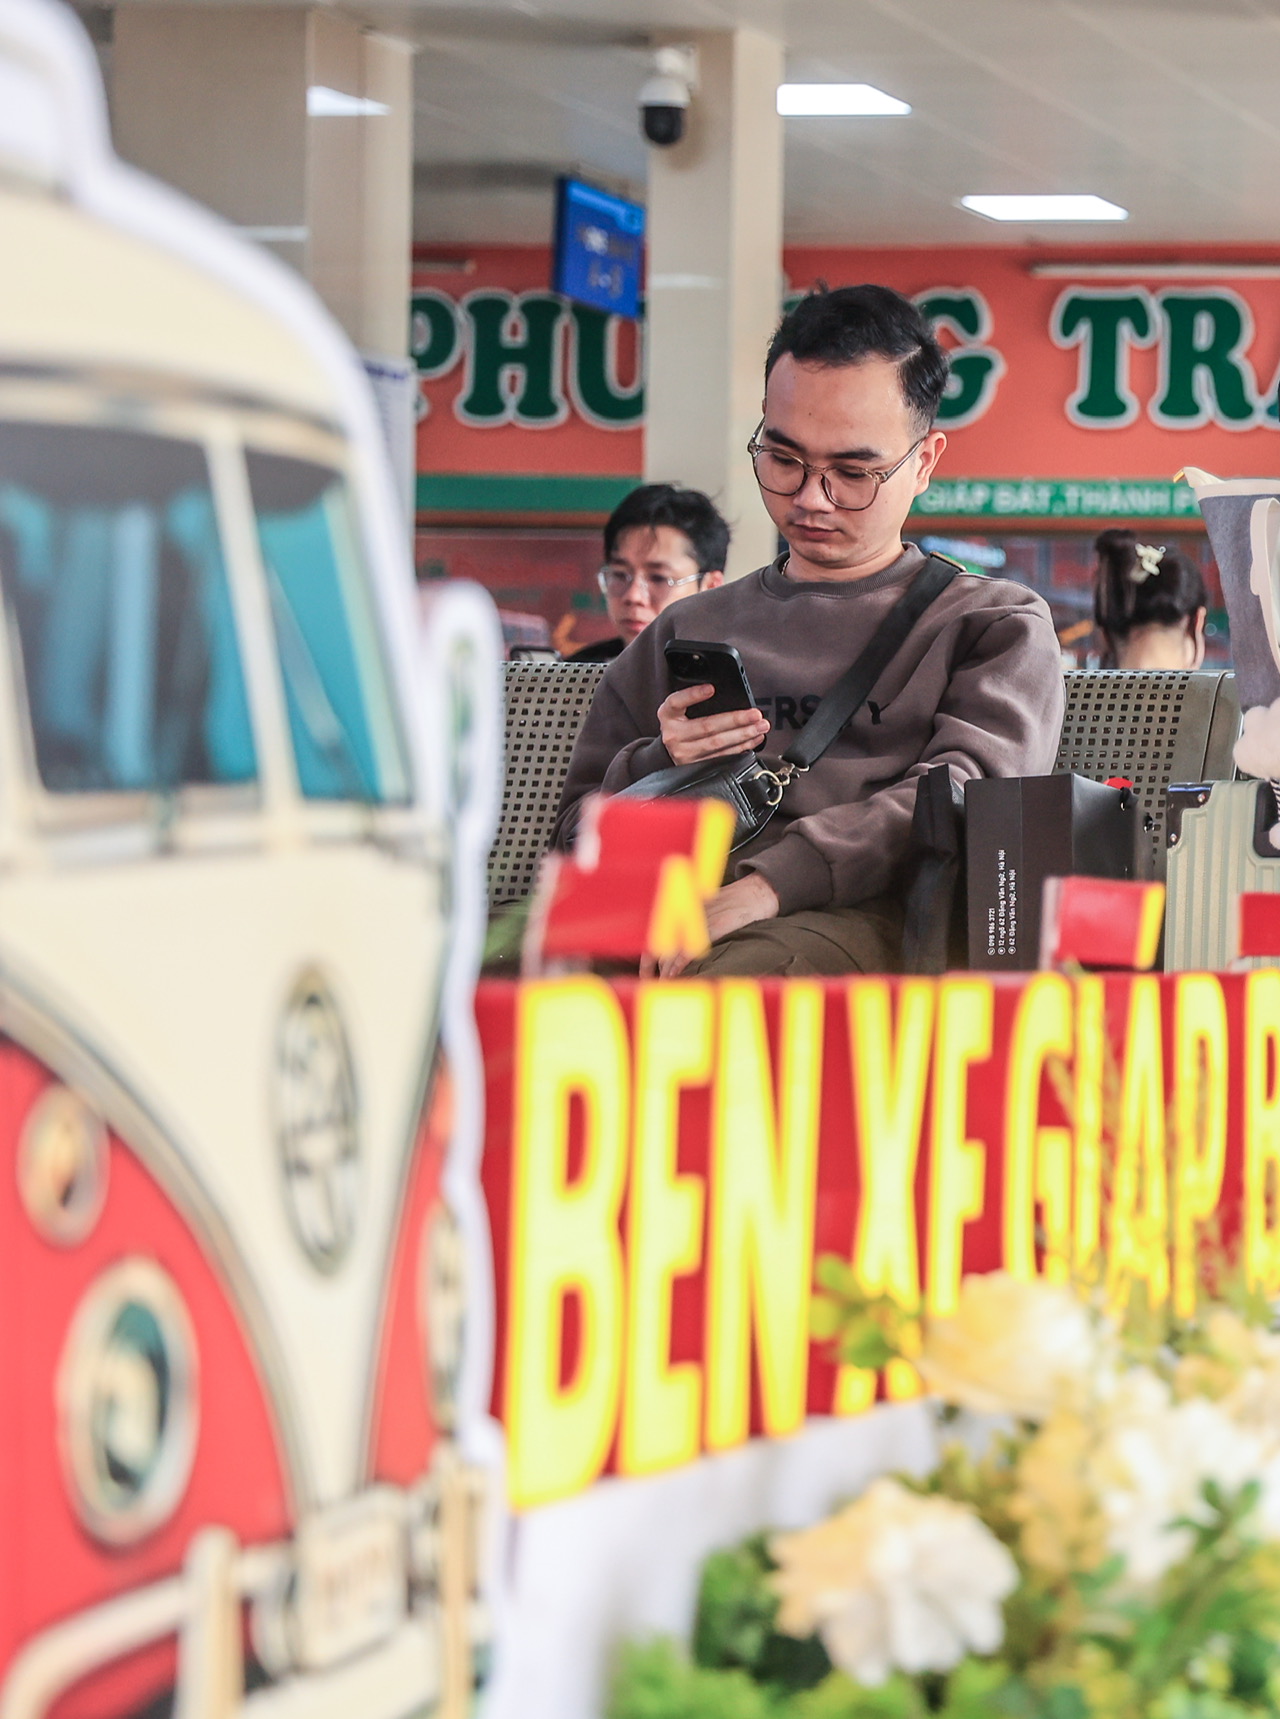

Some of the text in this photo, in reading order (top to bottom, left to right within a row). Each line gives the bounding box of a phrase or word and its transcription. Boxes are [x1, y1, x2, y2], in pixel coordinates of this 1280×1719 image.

[998, 849, 1006, 861] Nội
[998, 861, 1005, 871] Hà
[1009, 869, 1017, 881] Nội
[1009, 881, 1016, 891] Hà
[998, 917, 1005, 926] 62
